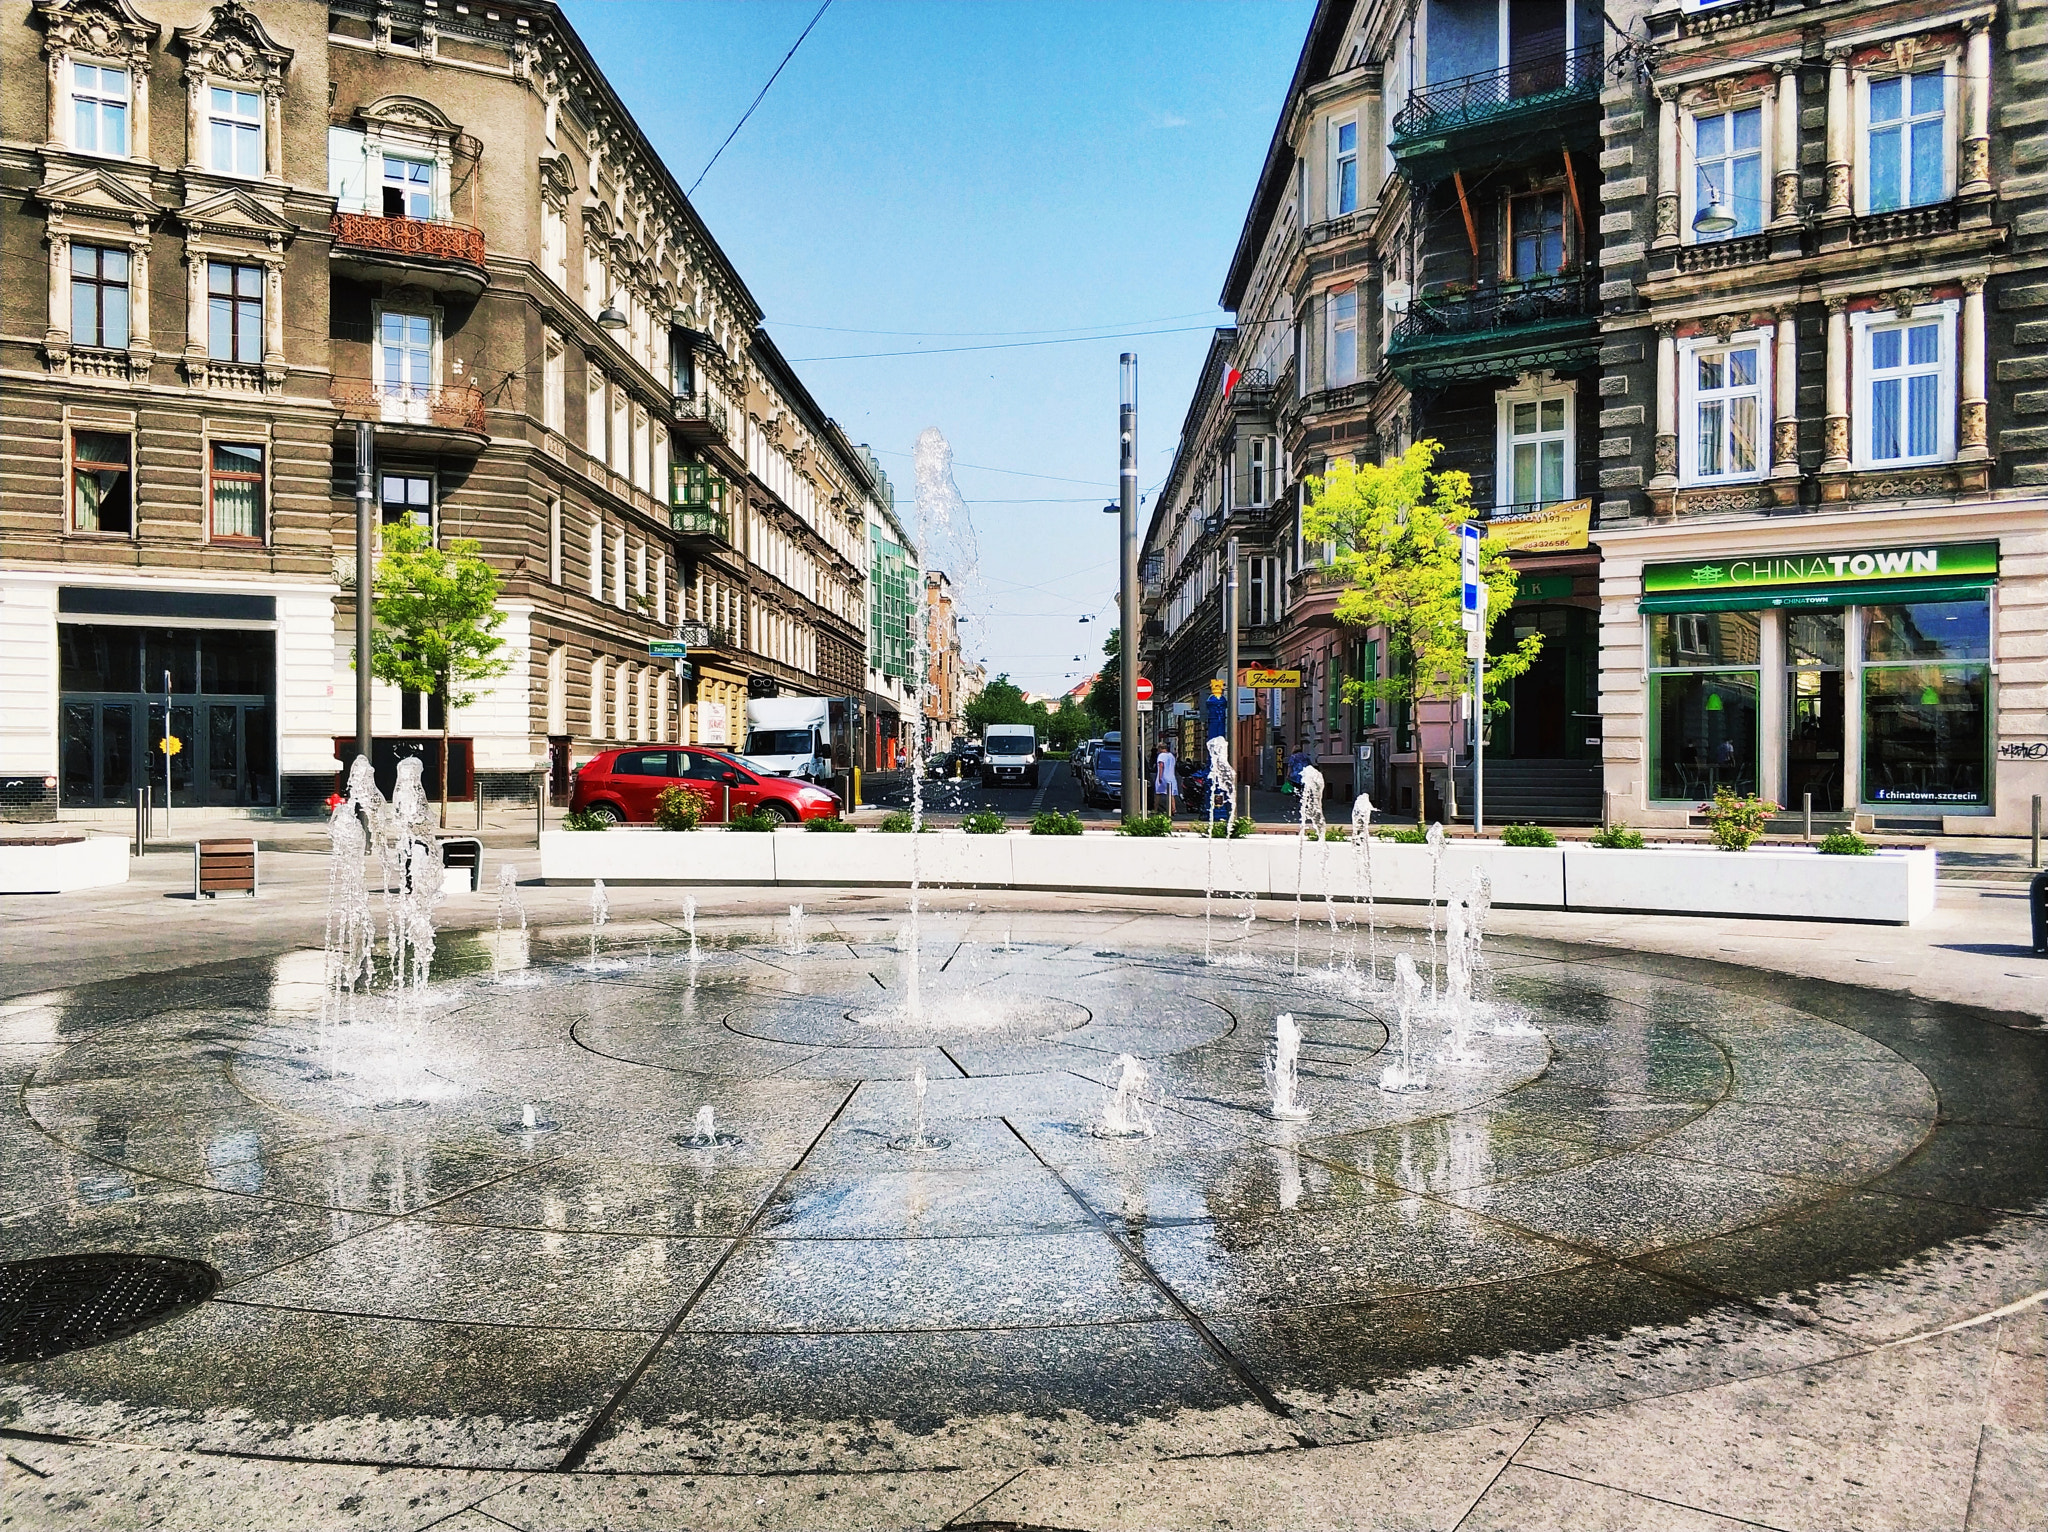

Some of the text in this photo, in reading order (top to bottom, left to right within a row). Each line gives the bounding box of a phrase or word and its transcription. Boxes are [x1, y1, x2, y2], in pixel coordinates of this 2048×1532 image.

[1730, 550, 1938, 584] CHINATOWN
[1783, 597, 1829, 605] CHINATOWN
[1886, 791, 1977, 800] chinatown.szczecin
